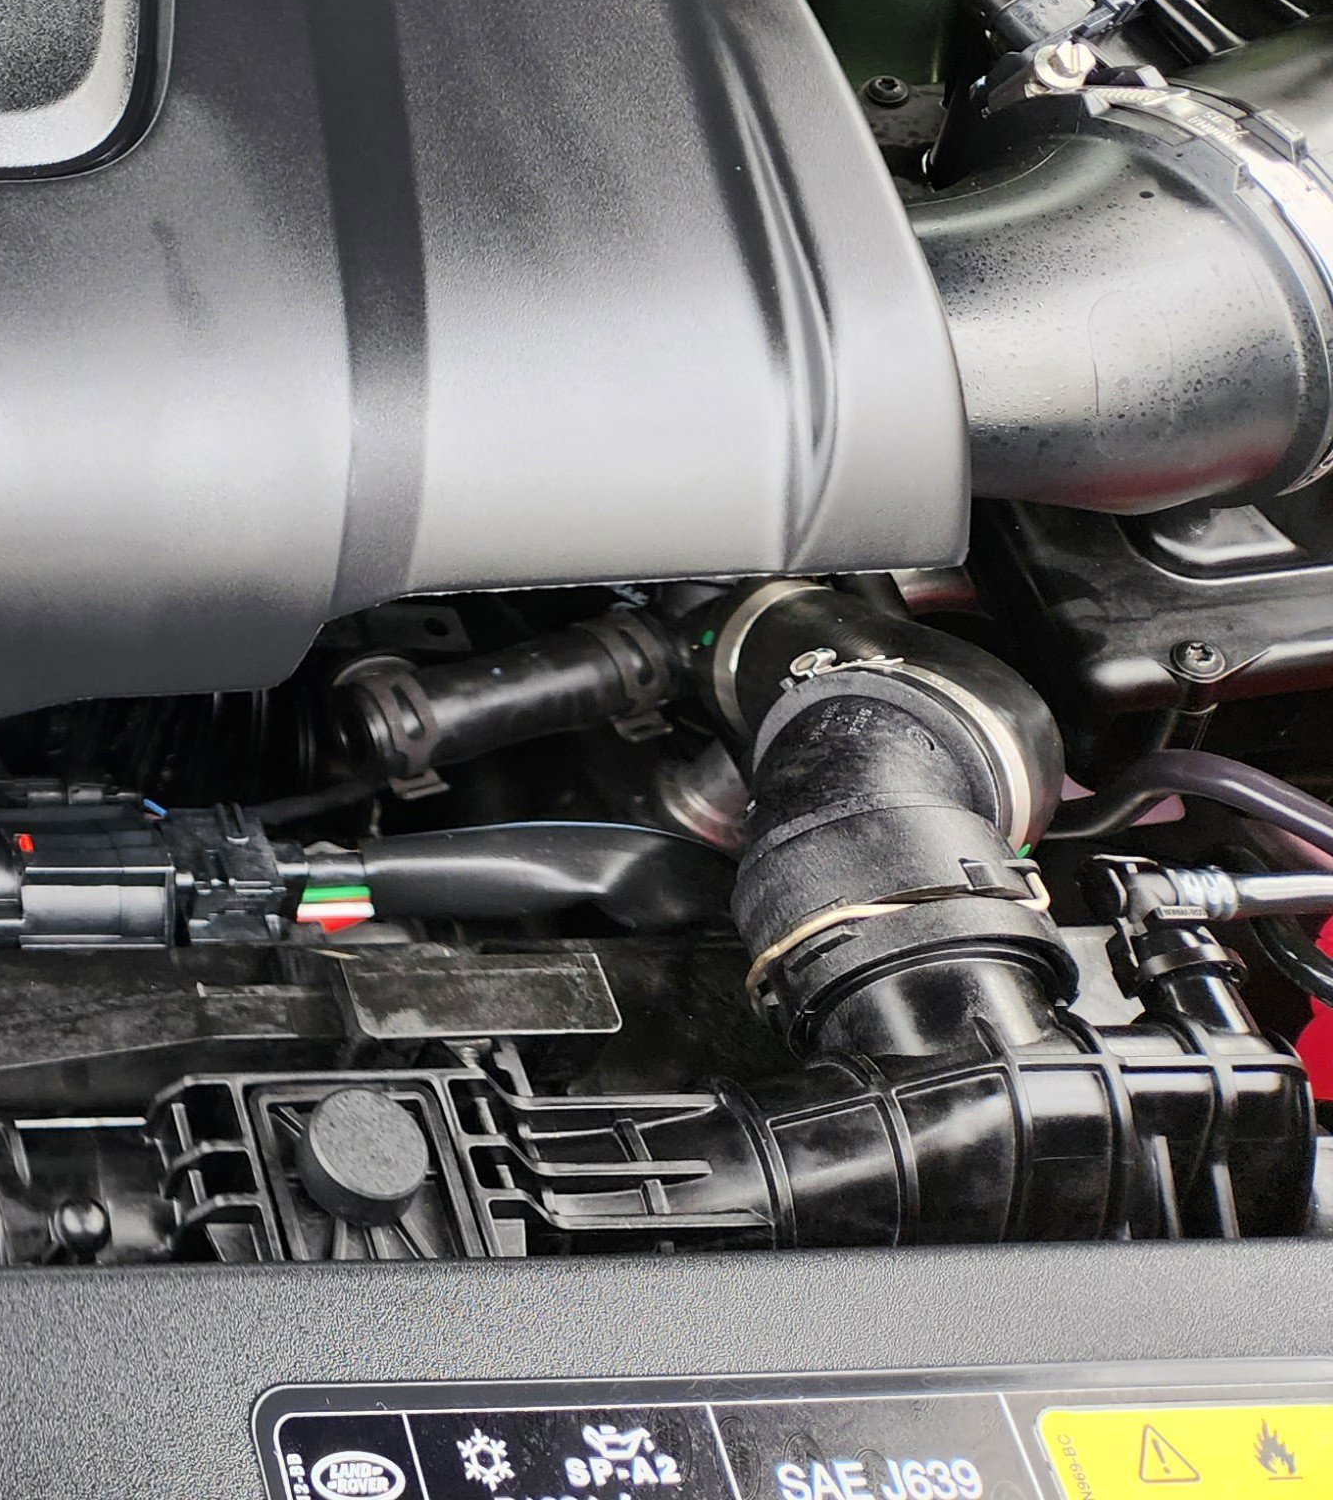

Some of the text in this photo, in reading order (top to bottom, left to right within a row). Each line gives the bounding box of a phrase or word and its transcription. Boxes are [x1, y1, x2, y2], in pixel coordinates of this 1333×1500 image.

[329, 1462, 373, 1480] LAND
[564, 1453, 682, 1487] SP-A2
[776, 1457, 983, 1500] SAE J639
[337, 1476, 391, 1494] ROVER
